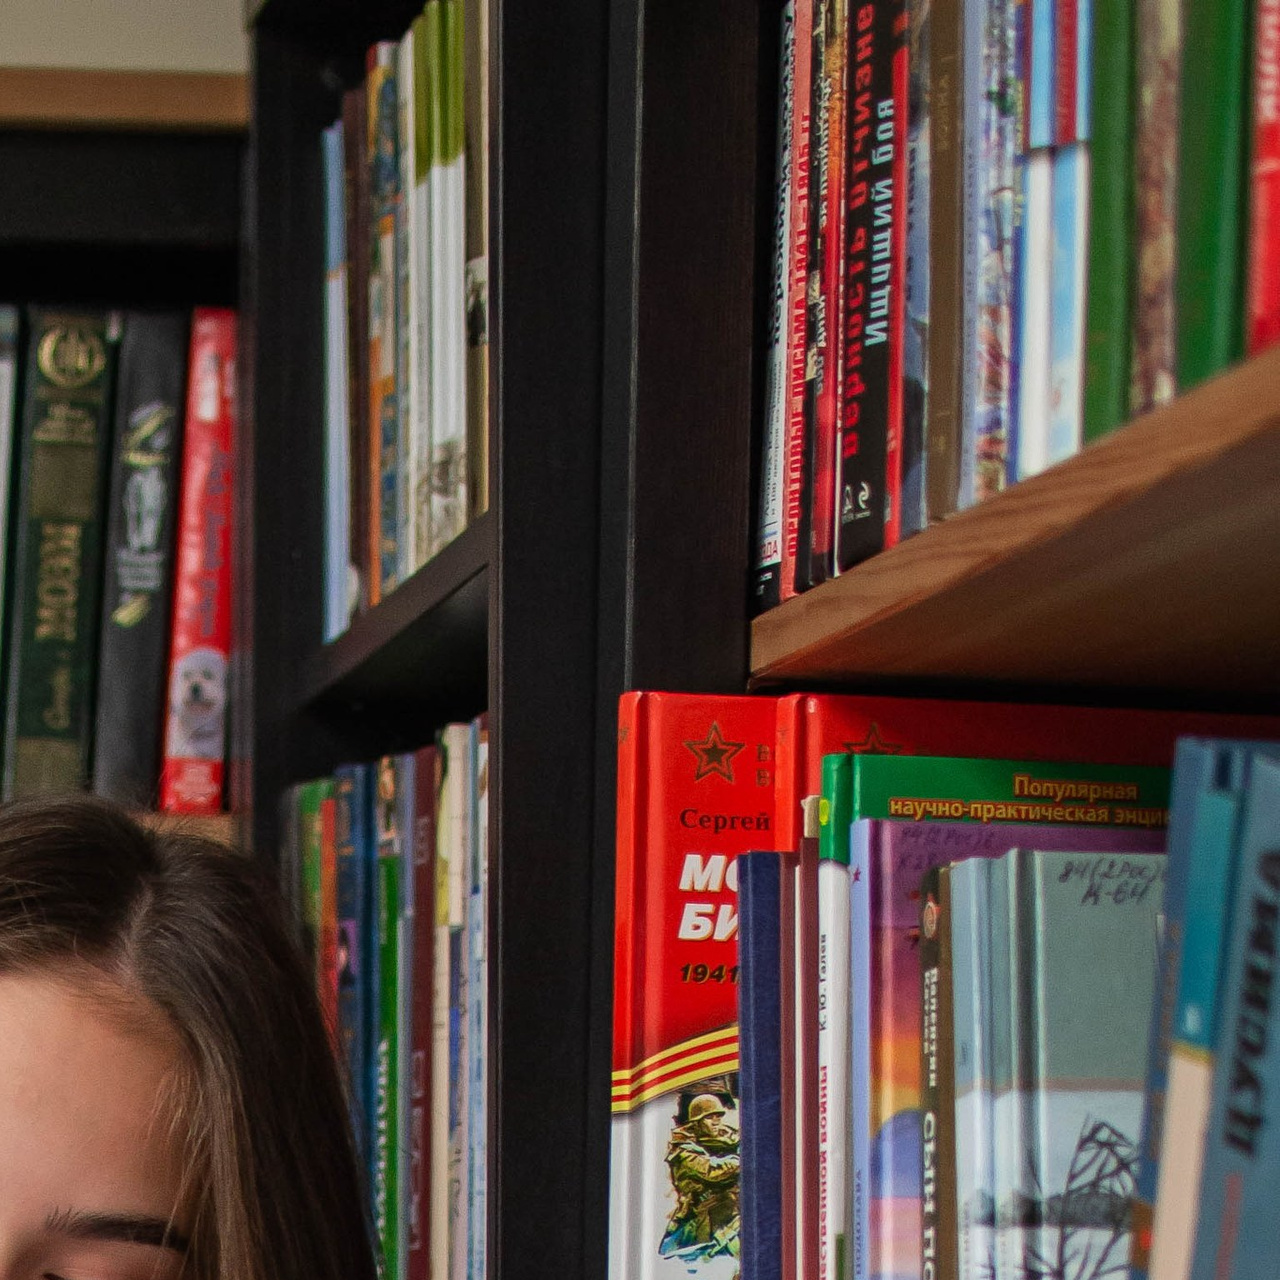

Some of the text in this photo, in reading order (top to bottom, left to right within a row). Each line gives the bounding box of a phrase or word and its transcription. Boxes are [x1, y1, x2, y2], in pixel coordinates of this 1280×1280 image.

[864, 98, 894, 347] Ищущий боя
[1013, 773, 1139, 801] Популярная
[679, 808, 770, 838] Сергей
[889, 799, 1111, 826] научно-практическая
[922, 1111, 937, 1214] СЫН
